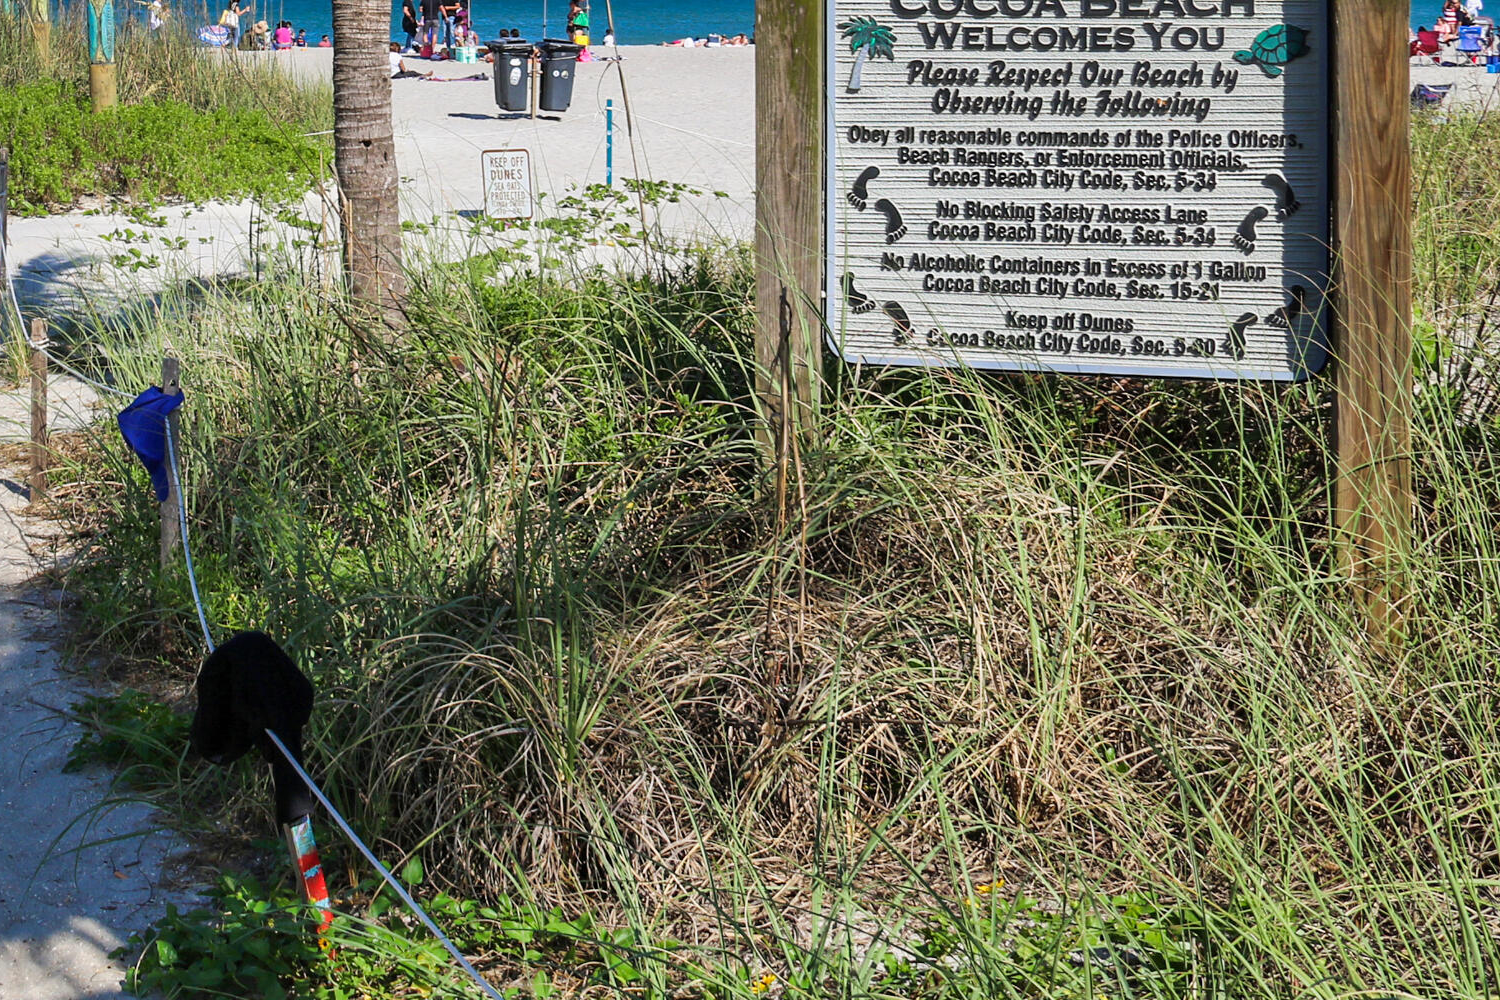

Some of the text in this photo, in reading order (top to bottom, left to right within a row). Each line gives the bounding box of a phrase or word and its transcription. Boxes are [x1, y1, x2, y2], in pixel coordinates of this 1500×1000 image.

[917, 22, 1135, 51] WELCOMES
[906, 60, 1238, 93] Please Respect Our Beach by
[931, 88, 1211, 123] Observing the Following
[848, 125, 1304, 150] Obey all reasonable commands of the Police Officers,
[490, 156, 524, 168] KEEP OFF
[898, 147, 950, 165] Beach
[953, 148, 1030, 168] Rangers,
[1034, 152, 1053, 167] or
[1056, 149, 1166, 168] Enforcement
[490, 168, 523, 181] DUNES
[493, 182, 504, 191] SEA
[929, 167, 980, 186] Cocoa
[984, 168, 1037, 188] Beach
[1041, 169, 1075, 192] City
[1078, 170, 1128, 191] Code,
[1174, 171, 1217, 192] 5-34
[490, 191, 526, 201] PROTECTED
[936, 200, 1208, 225] No Blocking Safety Access Lane
[928, 221, 980, 240] Cocoa
[984, 222, 1036, 242] Beach
[1040, 224, 1075, 246] City
[1078, 225, 1128, 246] Code,
[1174, 226, 1216, 247] 5-34
[880, 252, 905, 271] No
[908, 253, 985, 273] Alcoholic
[989, 255, 1080, 276] Containers
[1105, 258, 1166, 278] Excess
[1170, 260, 1189, 279] of
[1193, 260, 1202, 280] 1
[1209, 261, 1267, 281] Gallon
[923, 274, 974, 292] Cocoa
[979, 276, 1031, 295] Beach
[1036, 277, 1069, 300] City
[1073, 278, 1122, 300] Code,
[1170, 281, 1220, 301] 15-21
[1005, 311, 1134, 333] Keep off Dunes
[927, 328, 979, 347] Cocoa
[983, 330, 1036, 350] Beach
[1040, 332, 1074, 354] City
[1077, 334, 1127, 354] Code,
